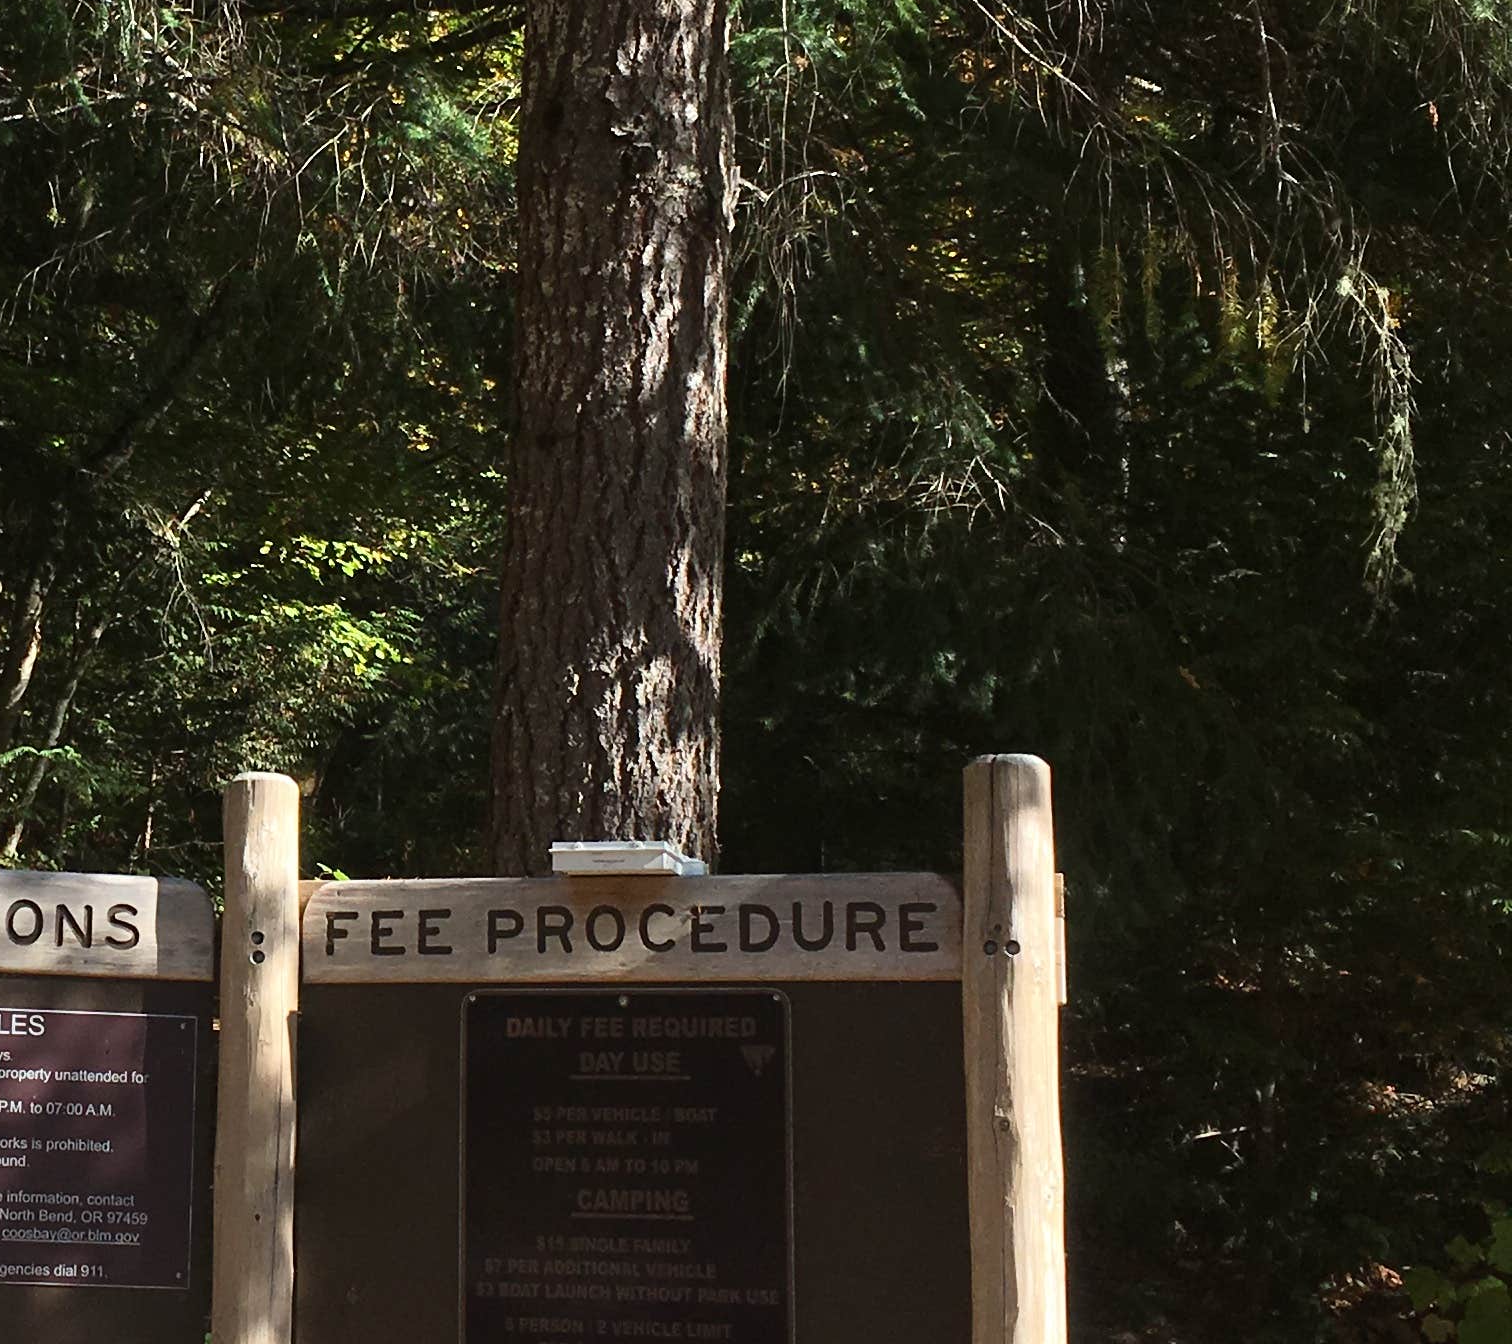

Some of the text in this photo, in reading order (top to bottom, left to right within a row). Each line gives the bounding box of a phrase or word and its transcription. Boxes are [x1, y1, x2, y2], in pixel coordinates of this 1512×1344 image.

[325, 900, 939, 957] FEE PROCEDURE
[505, 1017, 757, 1038] DAILY FEE REQUIRED
[579, 1051, 681, 1073] DAY USE
[55, 1070, 128, 1083] unattended
[131, 1071, 149, 1083] for
[30, 1103, 42, 1114] to
[46, 1102, 83, 1115] 07:00
[86, 1104, 116, 1117] A.M.
[32, 1138, 41, 1150] is
[46, 1138, 113, 1152] prohibited.
[87, 1195, 135, 1206] contact
[576, 1188, 690, 1213] CAMPING
[0, 1208, 34, 1221] North
[82, 1211, 102, 1222] OR
[107, 1212, 148, 1225] 97459
[54, 1265, 77, 1277] dial
